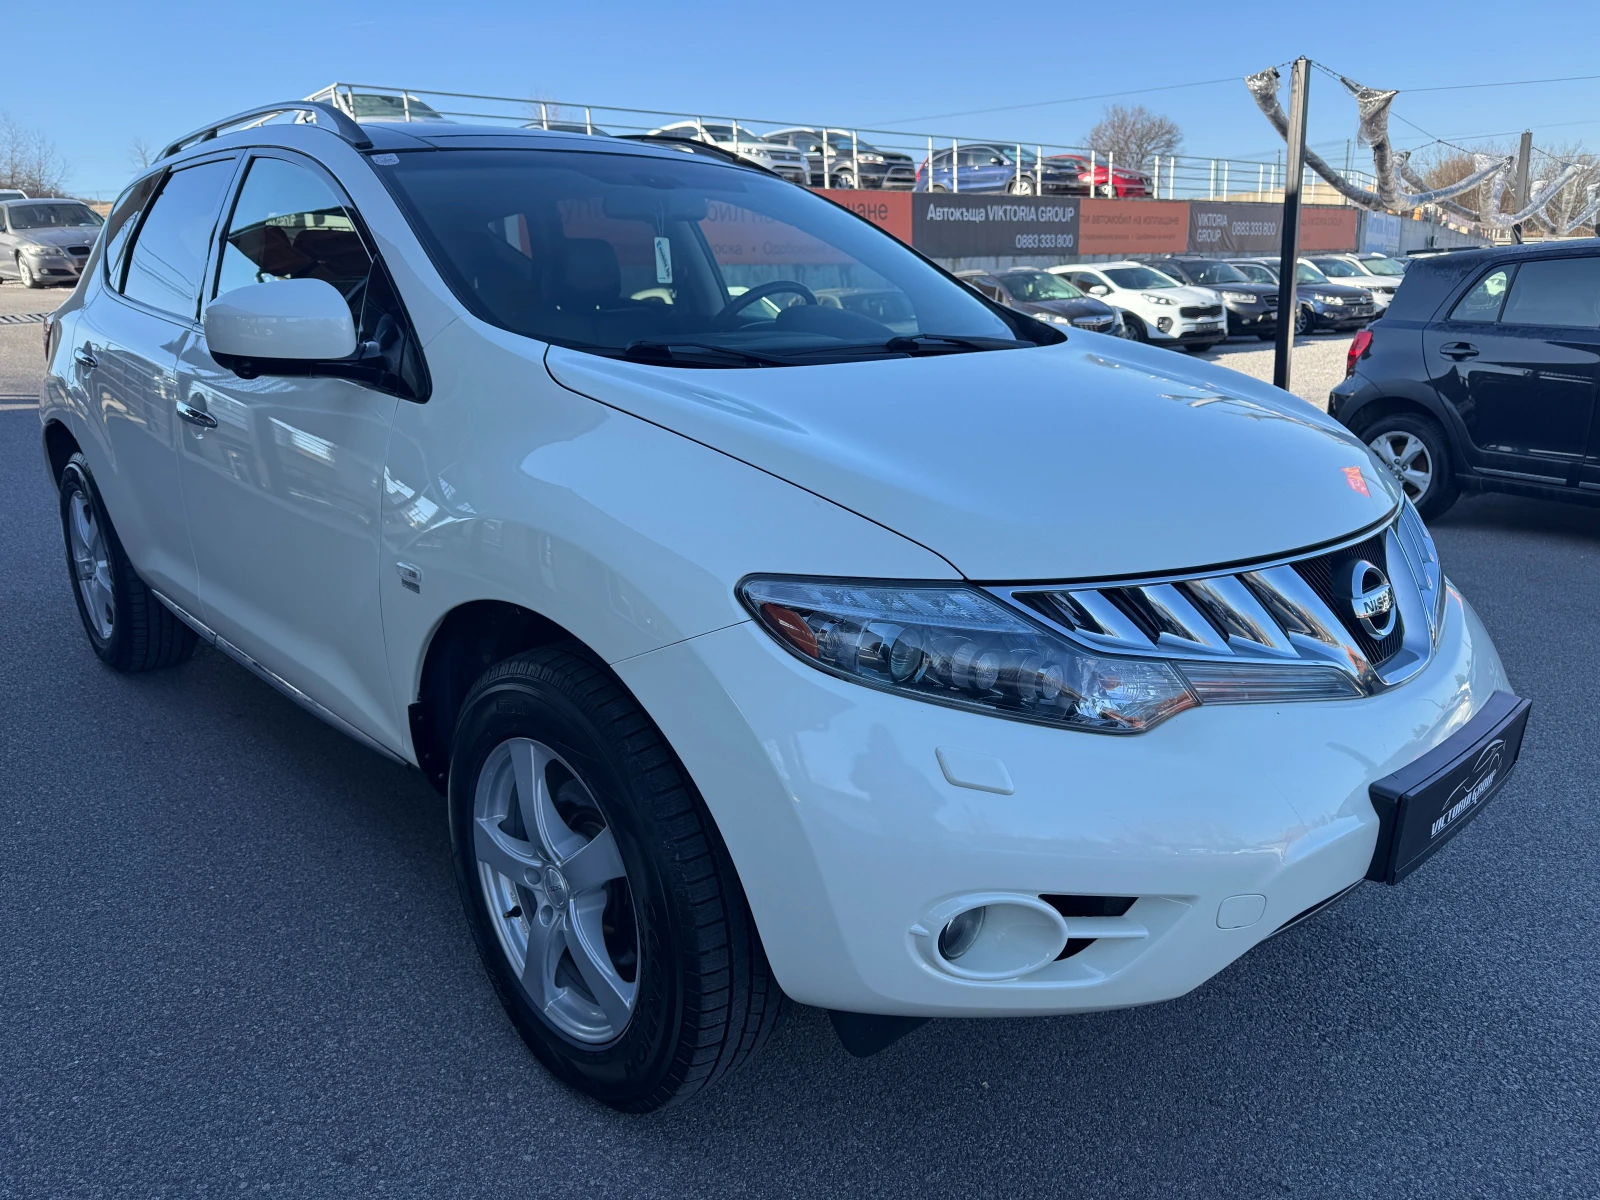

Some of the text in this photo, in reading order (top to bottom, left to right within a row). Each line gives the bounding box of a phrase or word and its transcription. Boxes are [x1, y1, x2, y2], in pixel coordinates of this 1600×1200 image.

[927, 203, 1075, 223] Автокъща VIKTORIA GROUP
[1197, 213, 1228, 227] VIKTORIA
[1196, 229, 1222, 242] GROUP
[1232, 221, 1276, 236] 0883 333 800
[1015, 234, 1038, 248] 0883
[1039, 234, 1056, 248] 333
[1057, 235, 1074, 248] 800
